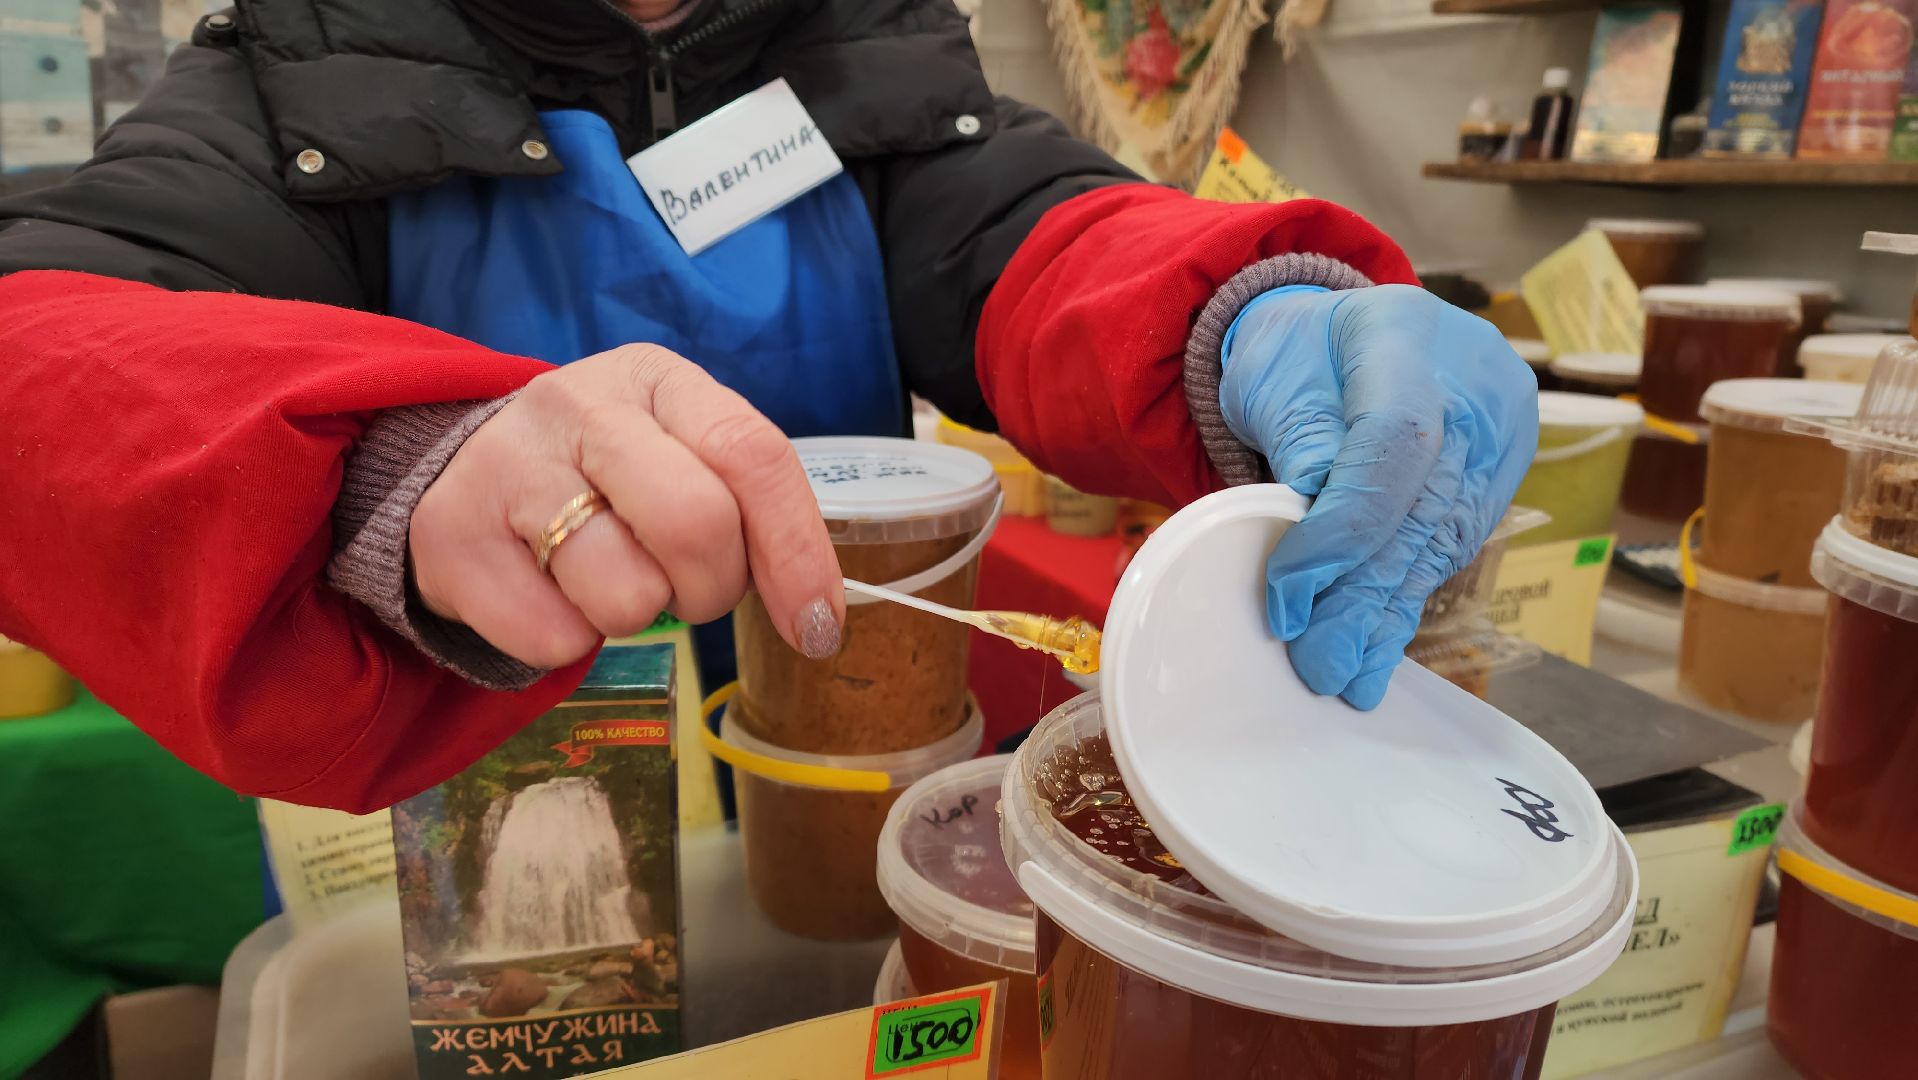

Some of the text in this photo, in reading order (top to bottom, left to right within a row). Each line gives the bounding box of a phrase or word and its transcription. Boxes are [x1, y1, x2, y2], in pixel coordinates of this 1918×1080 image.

[575, 726, 665, 741] 100% КАЧЕСТВО
[892, 1015, 974, 1061] 1500
[466, 1039, 624, 1075] АЛТАЯ
